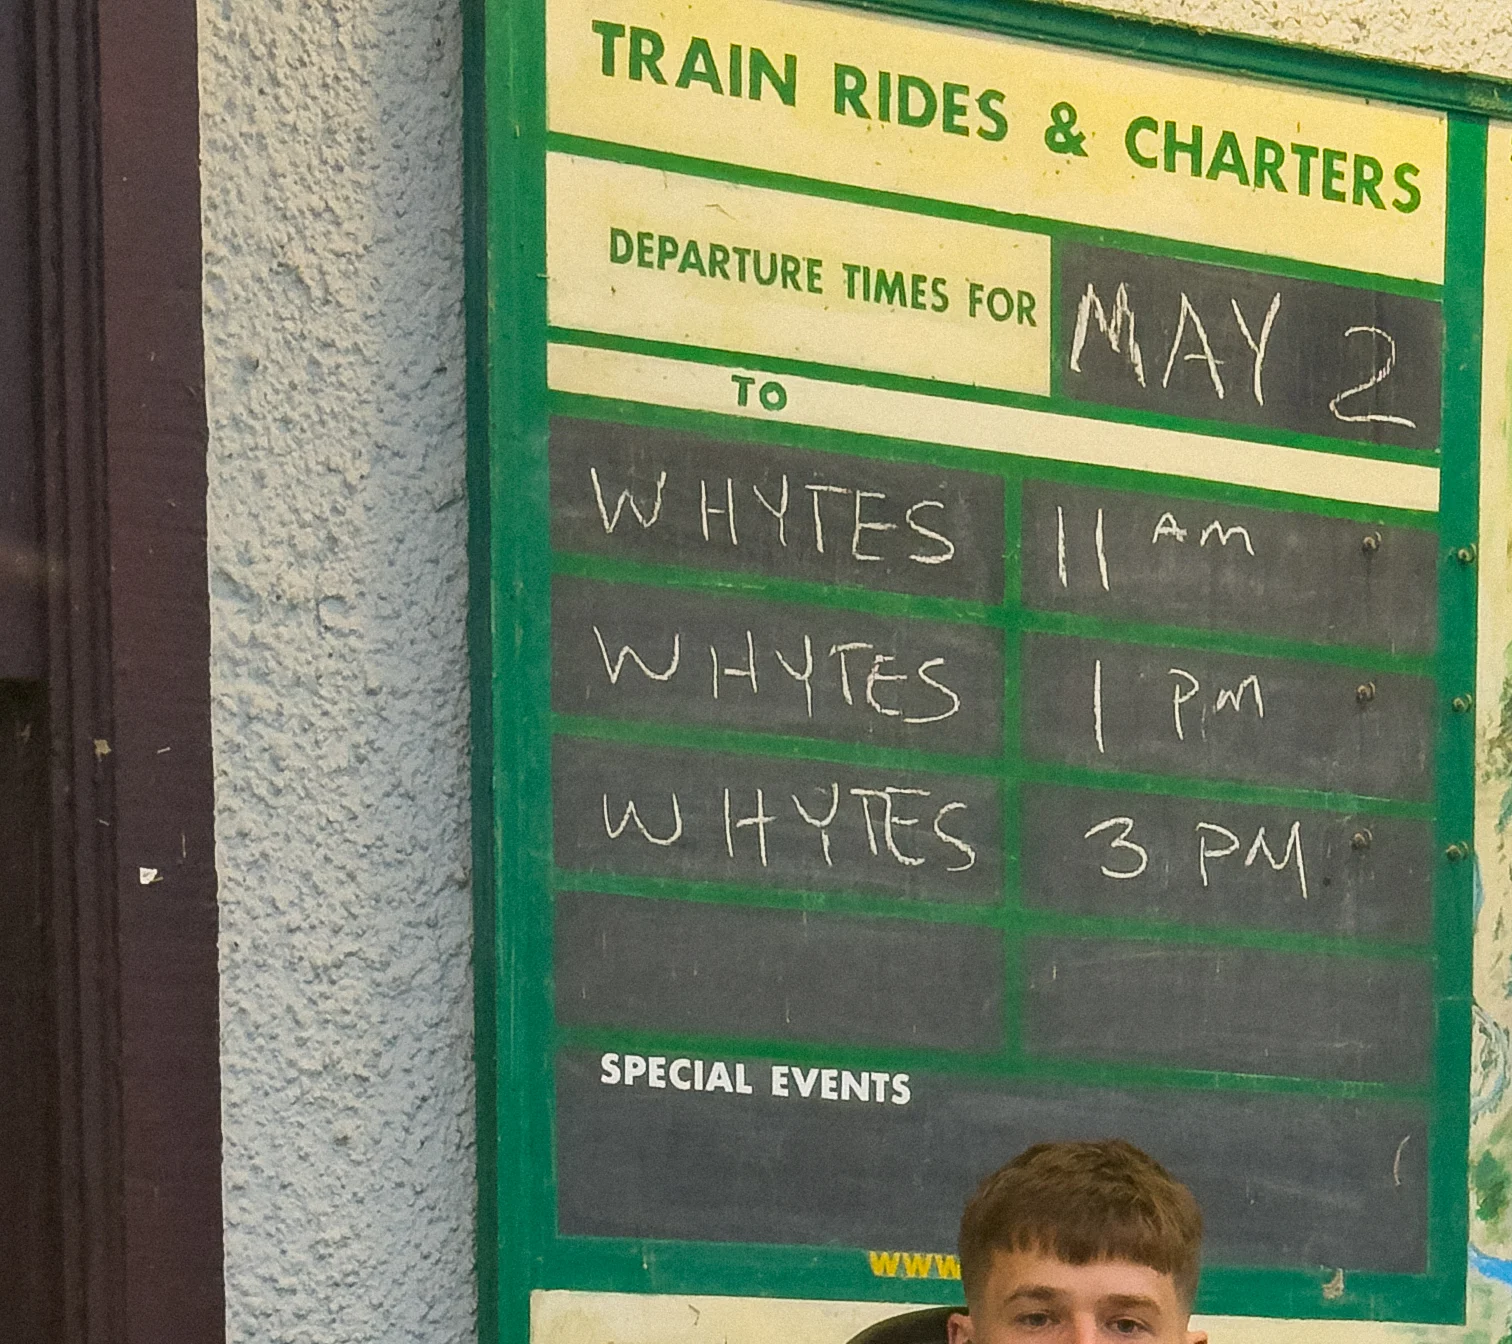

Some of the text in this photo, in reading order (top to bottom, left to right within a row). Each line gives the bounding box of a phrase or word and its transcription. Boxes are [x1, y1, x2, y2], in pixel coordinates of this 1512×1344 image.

[592, 20, 1422, 214] TRAIN RIDES & CHARTERS
[609, 226, 1038, 327] DEPARTURE TIMES FOR
[730, 375, 787, 412] TO
[1068, 281, 1416, 428] MAY 2
[590, 467, 957, 566] WHYTES
[1056, 506, 1110, 592] 11
[594, 626, 961, 724] WHYTES
[1093, 659, 1106, 753] 1
[602, 783, 1310, 899] WHYTES 3 PM
[601, 1052, 912, 1107] SPECIAL EVENTS
